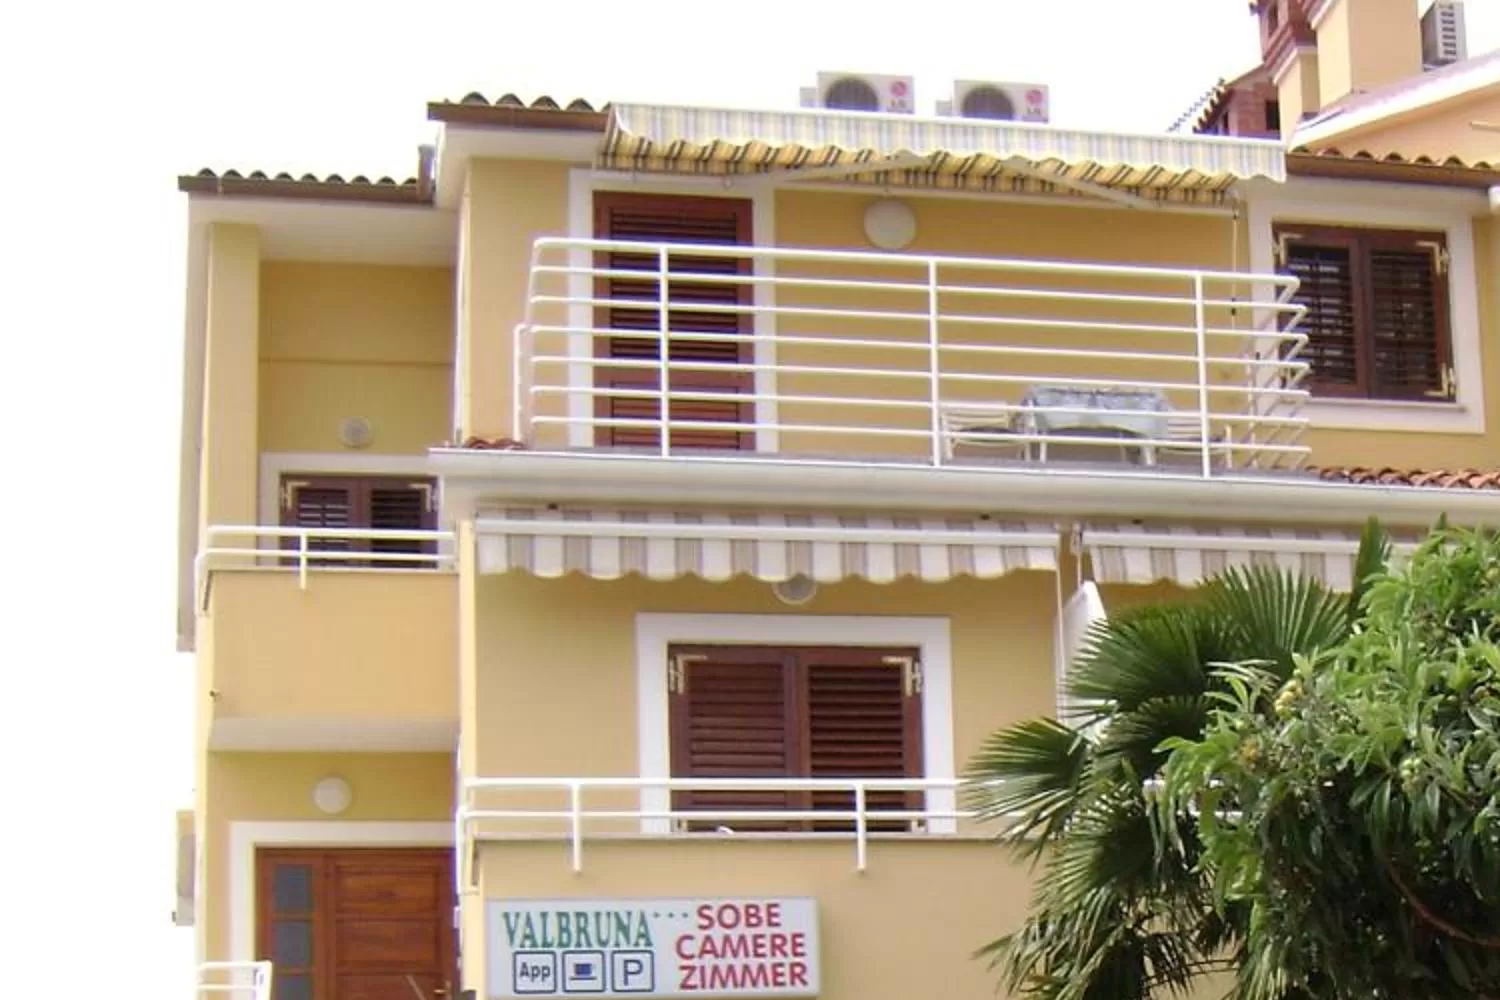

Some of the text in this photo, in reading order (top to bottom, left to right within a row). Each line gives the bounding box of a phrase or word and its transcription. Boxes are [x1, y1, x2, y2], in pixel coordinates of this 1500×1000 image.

[503, 910, 653, 948] VALBRUNA
[697, 903, 781, 930] SOBE
[675, 932, 807, 960] CAMERE
[520, 961, 551, 983] App
[623, 959, 644, 986] P
[679, 962, 809, 990] ZIMMER
